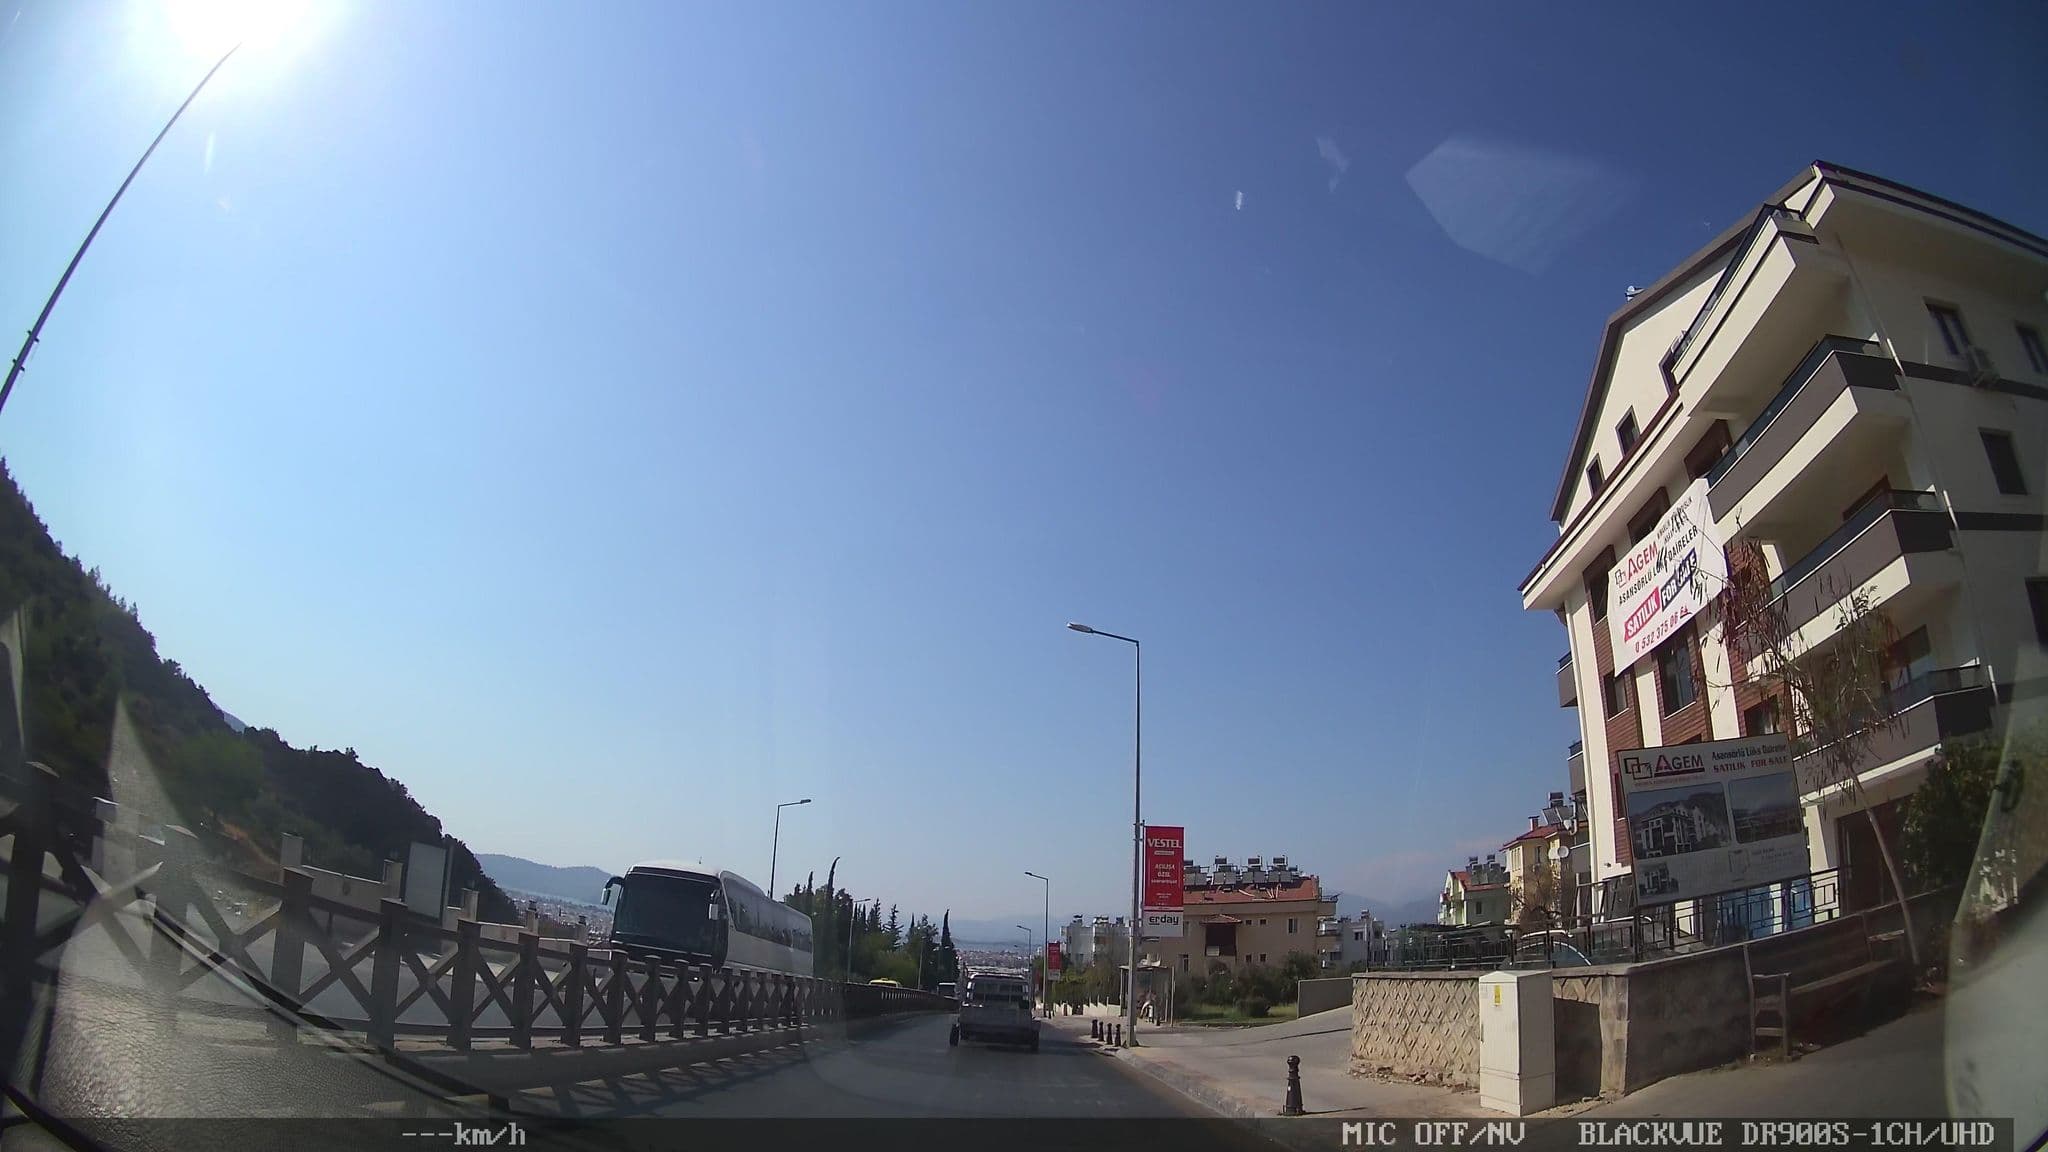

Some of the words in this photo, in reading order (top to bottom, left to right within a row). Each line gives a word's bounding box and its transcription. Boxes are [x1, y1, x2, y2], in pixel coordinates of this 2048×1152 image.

[1628, 541, 1659, 580] AGEM
[1627, 595, 1659, 637] SATILIK
[1661, 578, 1678, 606] FOR
[1641, 630, 1655, 650] 532
[1656, 620, 1669, 640] 375
[1655, 754, 1704, 773] AGEM
[1713, 761, 1746, 774] SATILIK
[1751, 758, 1767, 768] FOR
[1147, 838, 1182, 849] VESTEL
[1148, 914, 1179, 926] erday
